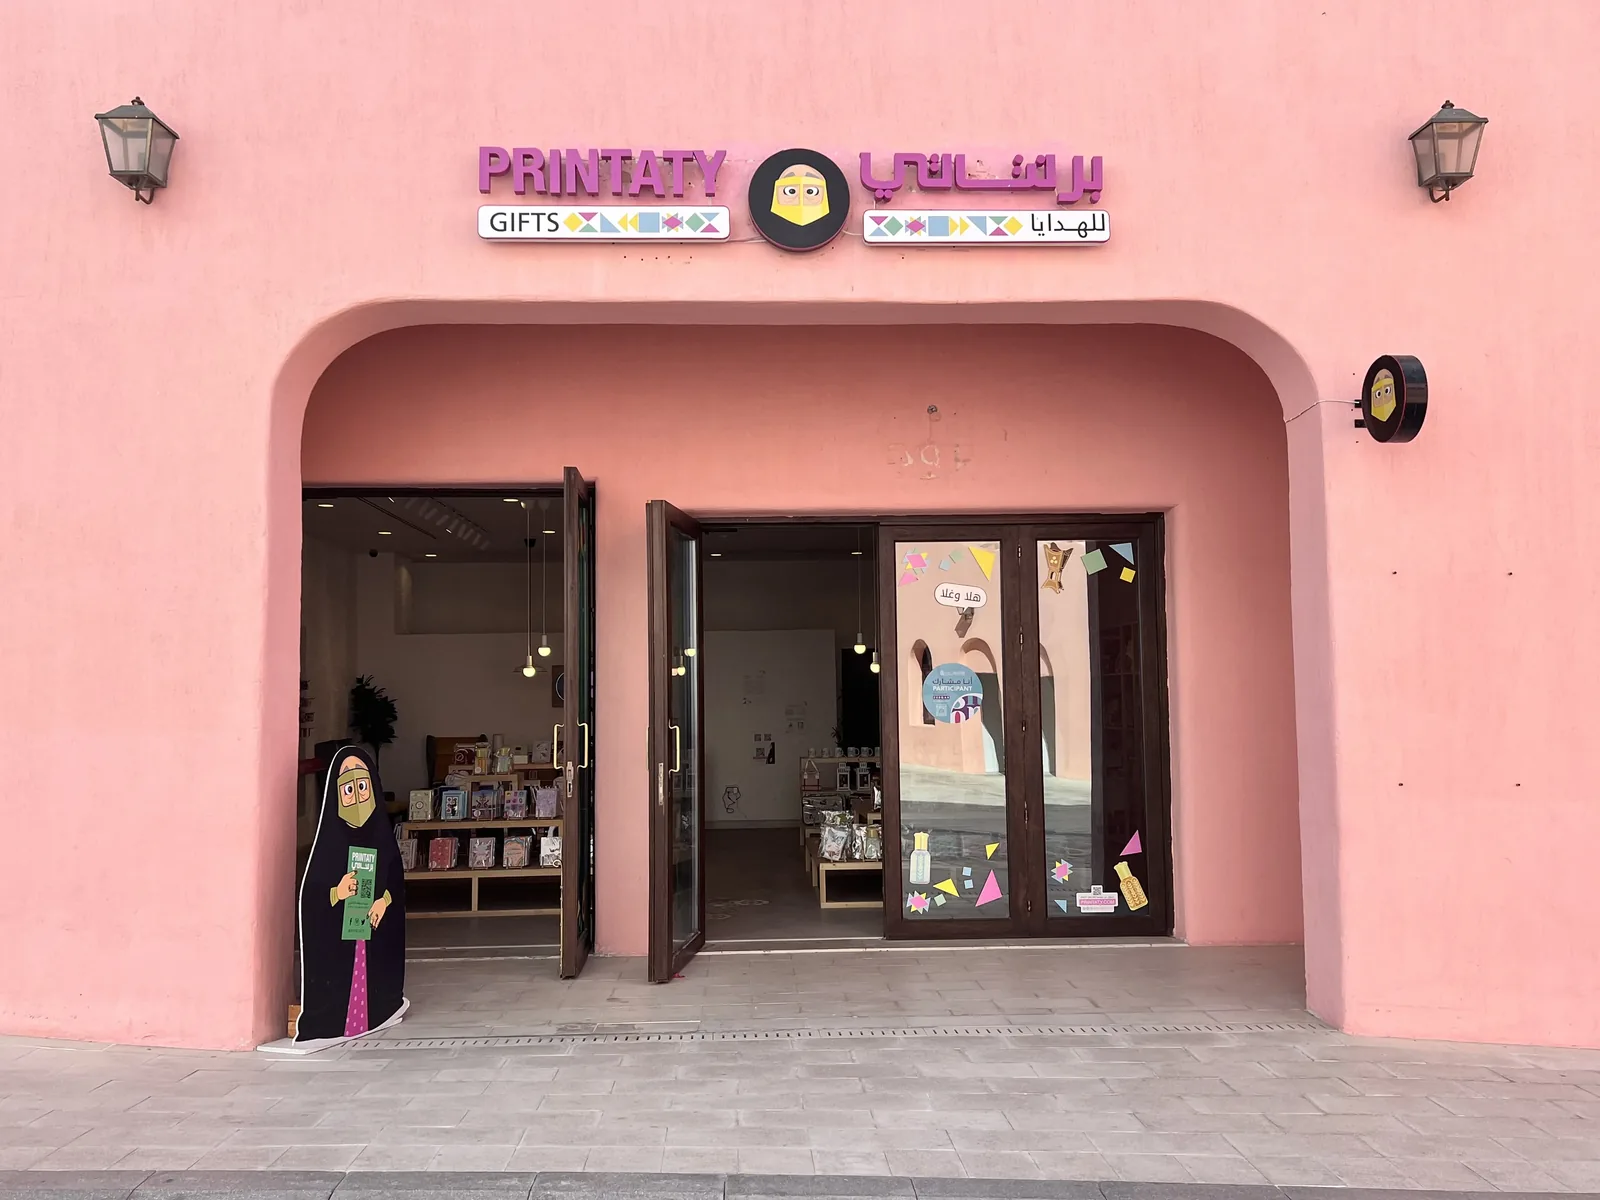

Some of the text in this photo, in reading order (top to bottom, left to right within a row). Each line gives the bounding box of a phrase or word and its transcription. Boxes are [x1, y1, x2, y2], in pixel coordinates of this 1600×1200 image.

[479, 147, 726, 198] PRINTATY
[859, 152, 1102, 205] برنتاتي
[489, 212, 560, 233] GIFTS
[1031, 213, 1105, 238] للهدايا
[940, 588, 981, 603] هلا وغلا
[932, 676, 973, 686] أنا مشارك
[352, 852, 376, 863] PRINTATY
